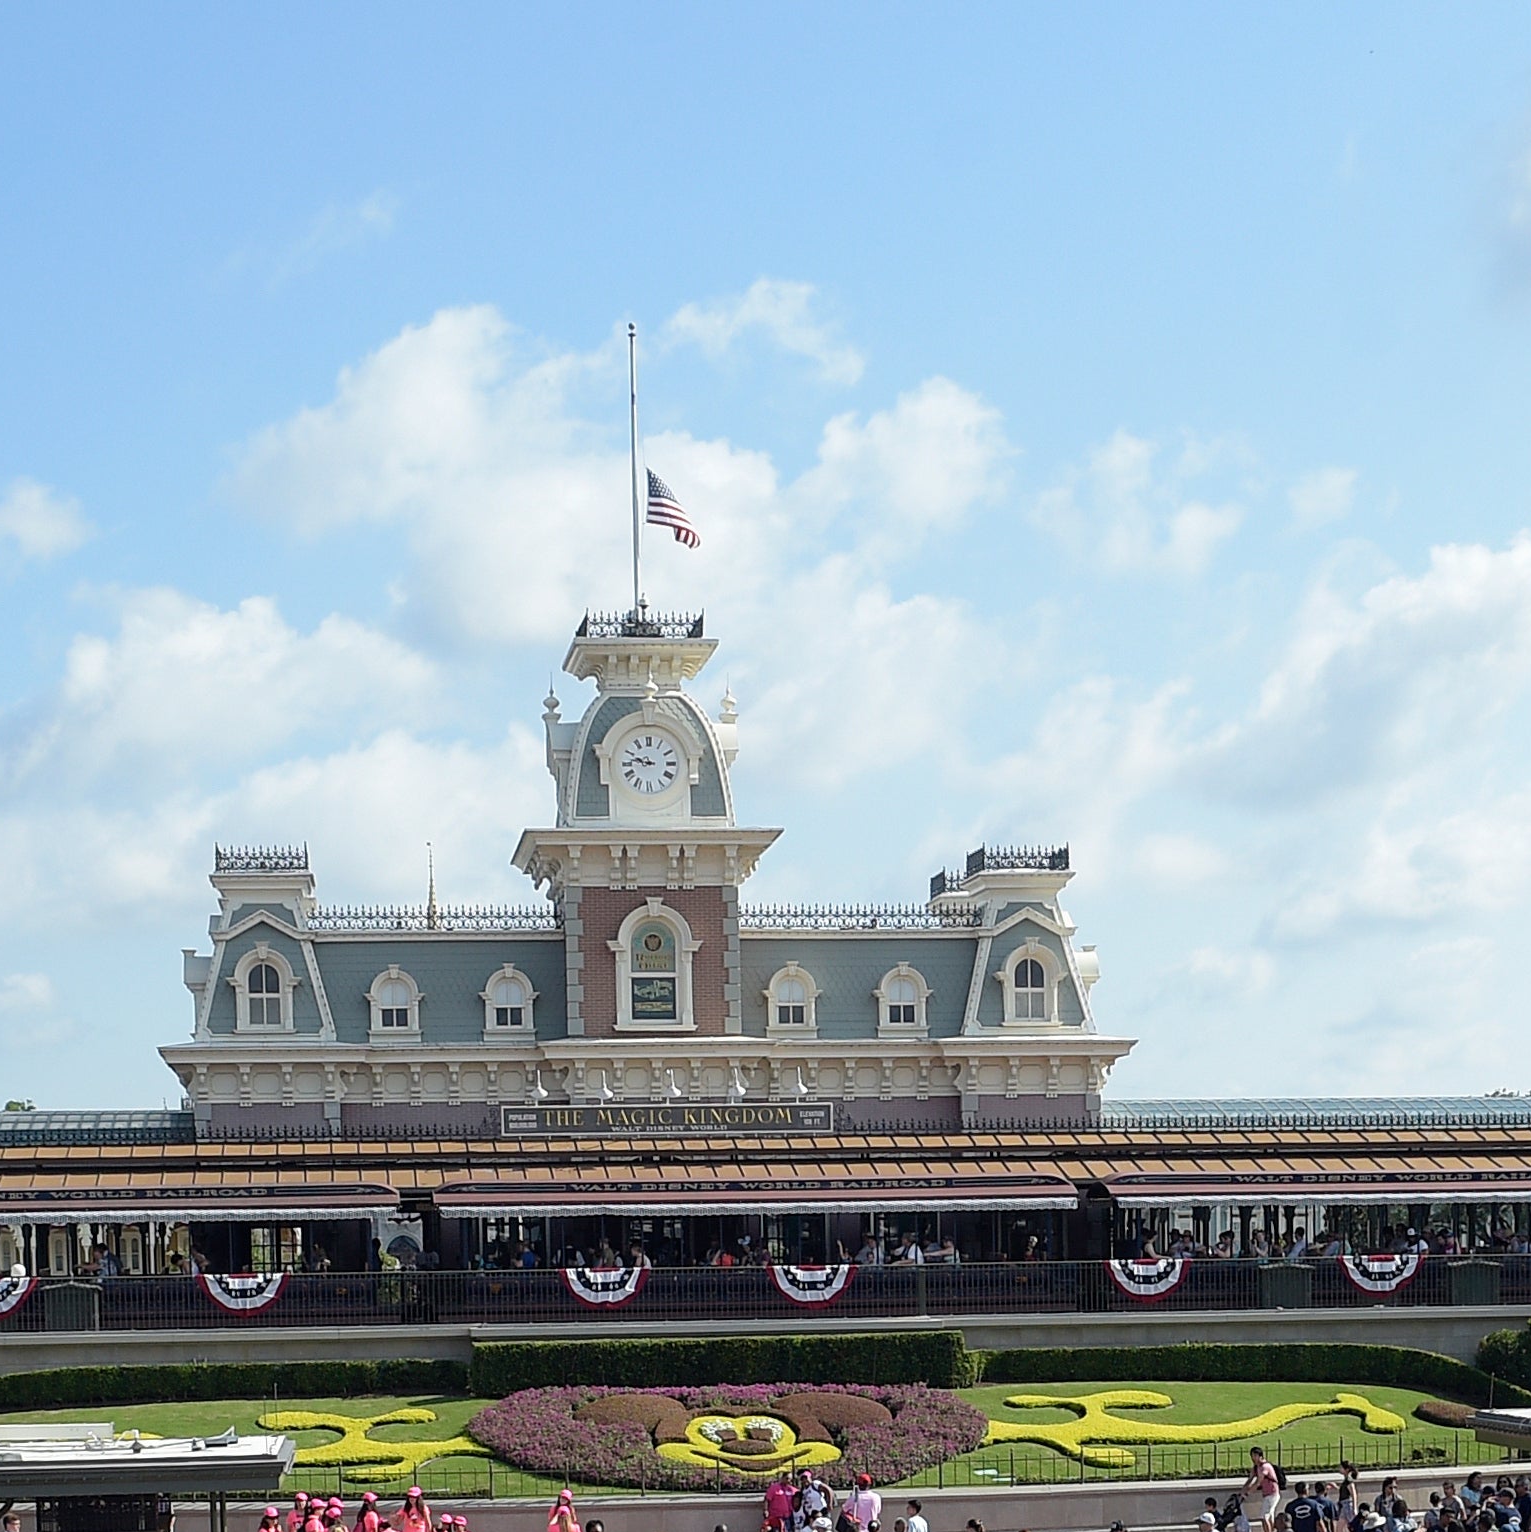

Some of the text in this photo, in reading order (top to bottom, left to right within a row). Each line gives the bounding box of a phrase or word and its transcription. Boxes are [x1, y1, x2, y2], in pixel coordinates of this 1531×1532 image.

[543, 1109, 585, 1126] THE
[596, 1109, 672, 1126] MAGIC
[684, 1107, 793, 1125] KINGDOM
[1235, 1175, 1294, 1183] WALT
[1302, 1174, 1386, 1182] DISNEY
[1396, 1173, 1472, 1181] WORLD
[570, 1179, 946, 1192] WALT DISNEY WORLD RAILROAD
[50, 1190, 136, 1199] WORLD
[146, 1188, 268, 1197] RAILROAD
